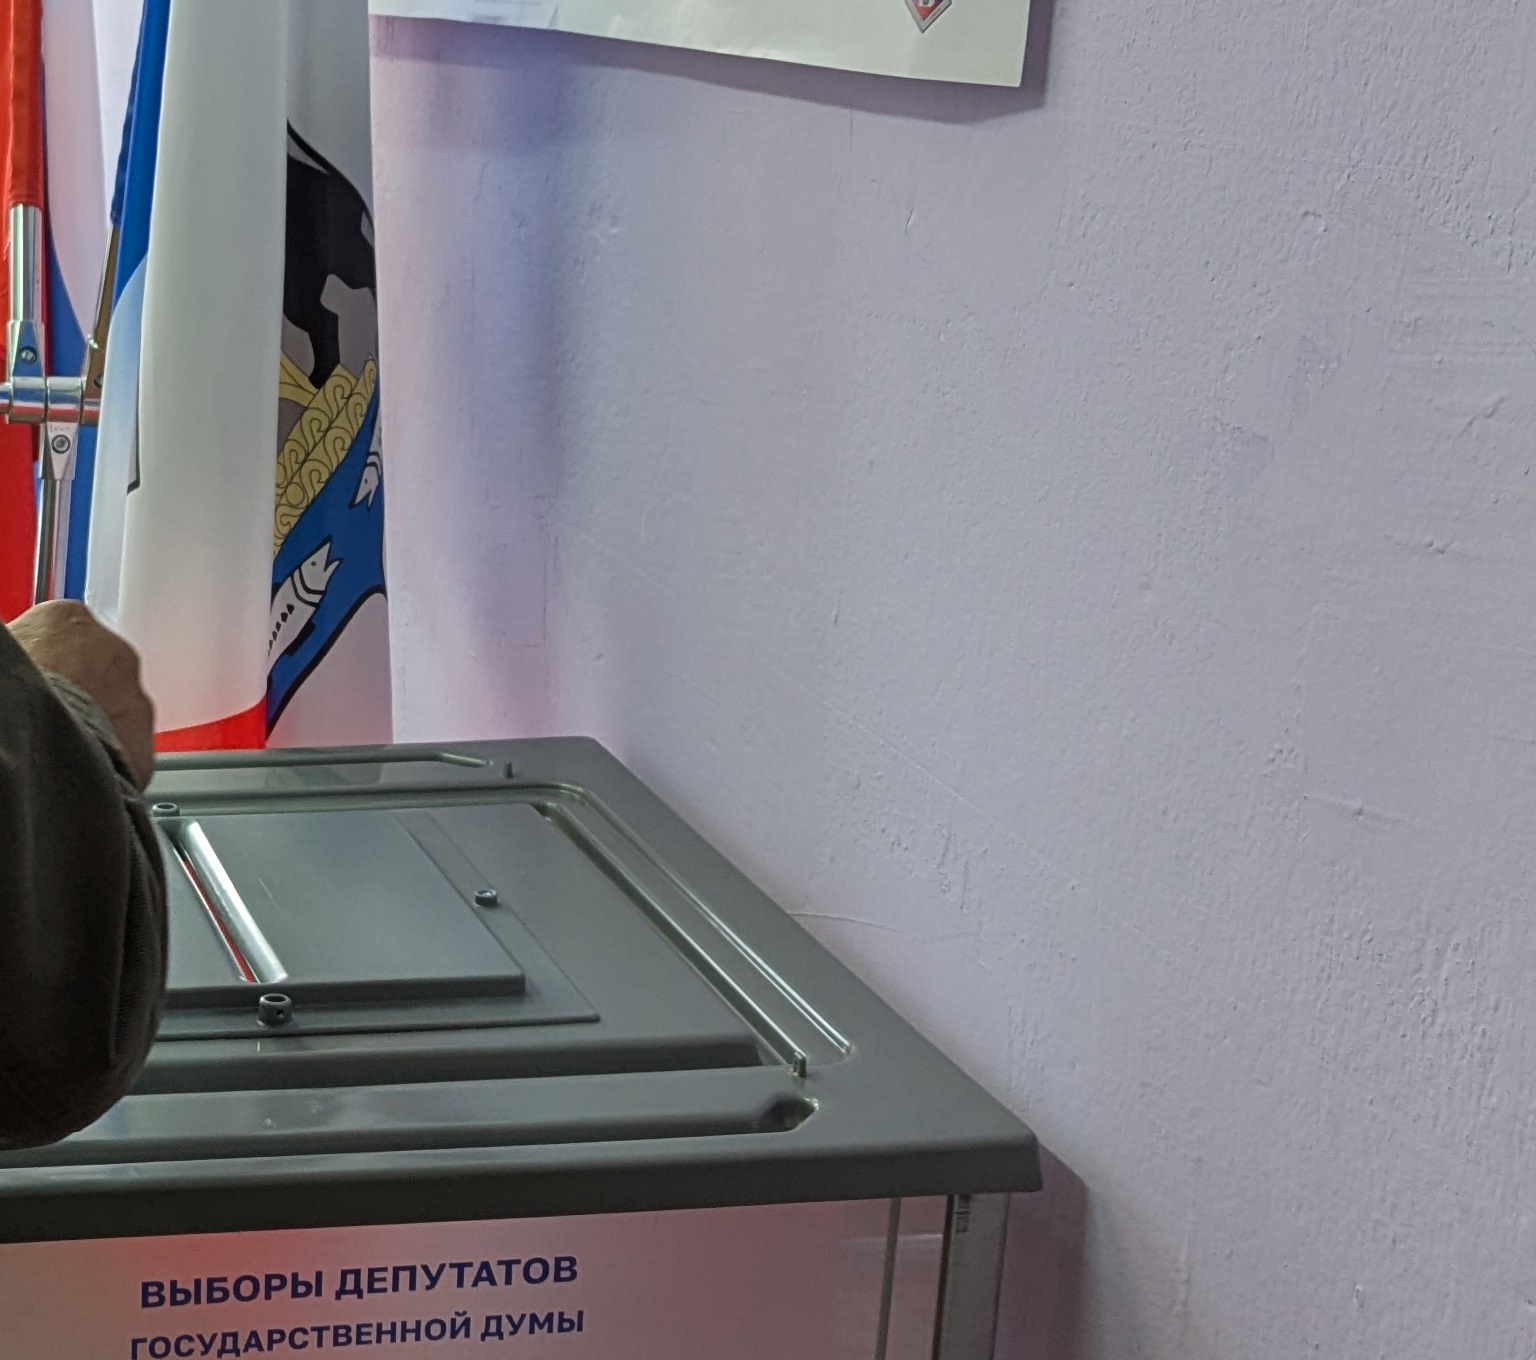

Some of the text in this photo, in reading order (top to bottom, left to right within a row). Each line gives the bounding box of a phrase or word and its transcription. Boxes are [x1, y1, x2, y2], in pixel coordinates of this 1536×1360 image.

[140, 1255, 578, 1309] ВЫБОРЫ ДЕПУТАТОВ
[129, 1310, 585, 1360] ГОСУДАРСТВЕННОЙ ДУМЫ
